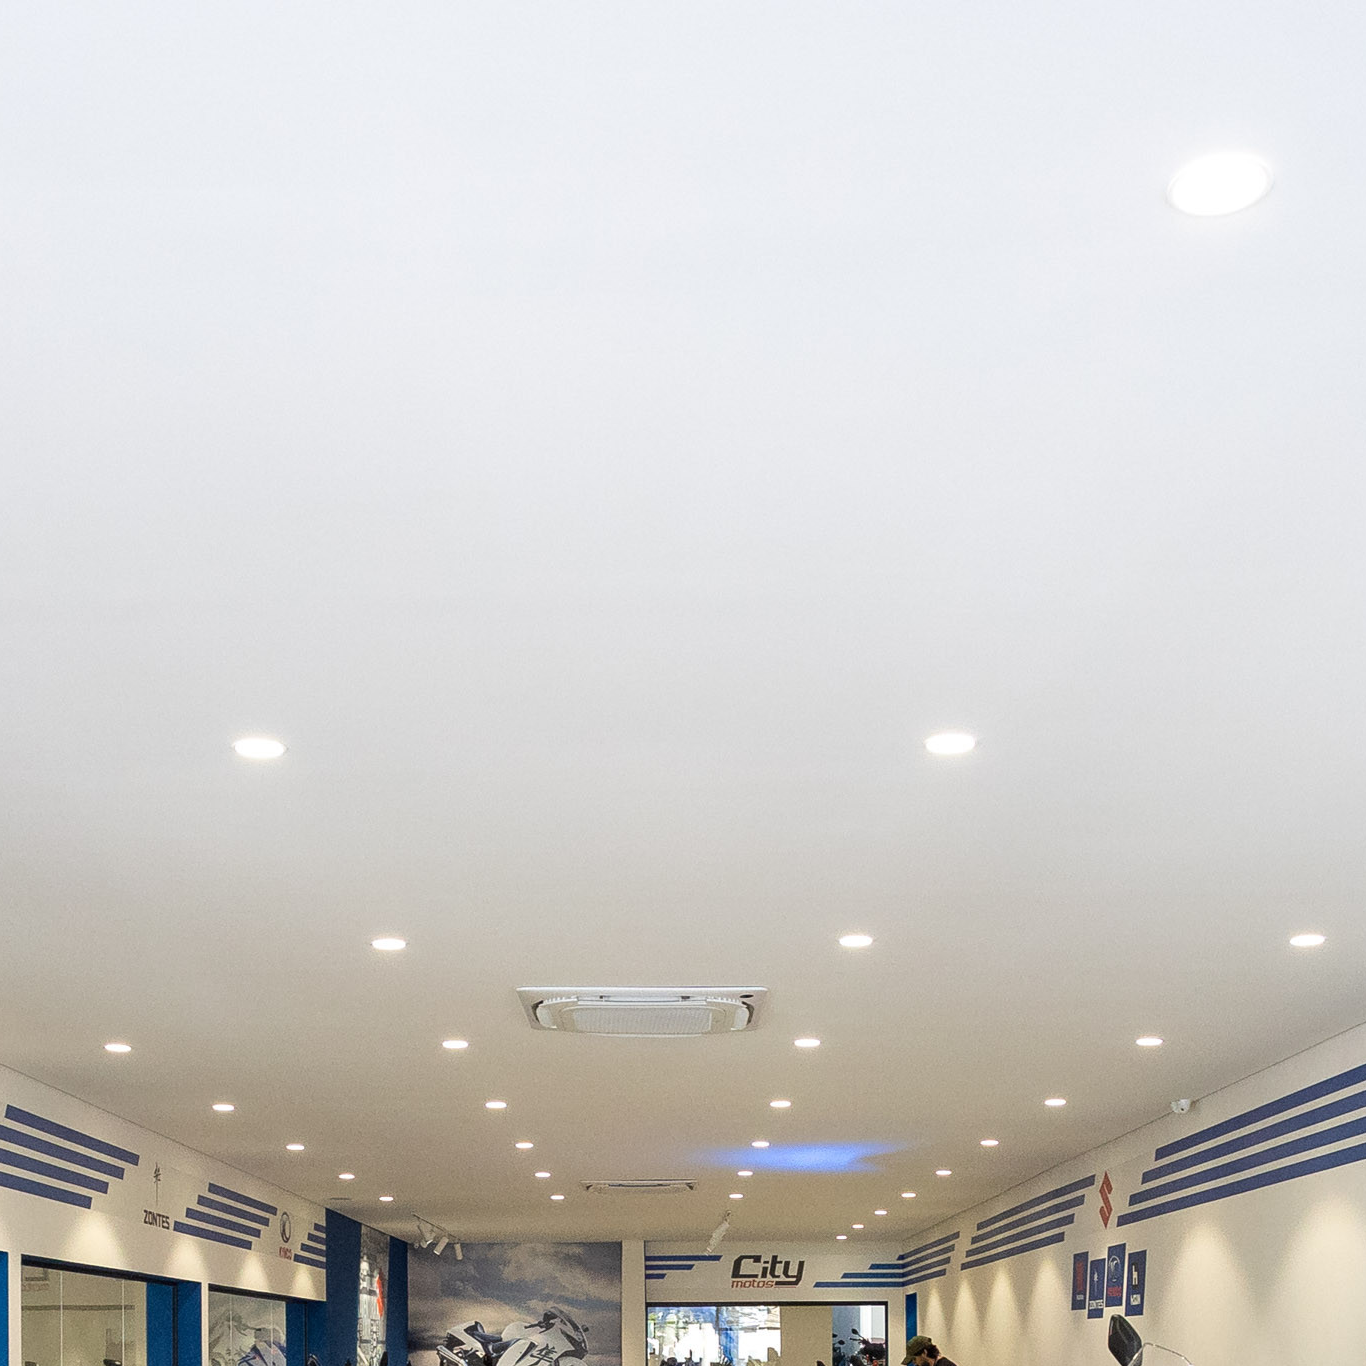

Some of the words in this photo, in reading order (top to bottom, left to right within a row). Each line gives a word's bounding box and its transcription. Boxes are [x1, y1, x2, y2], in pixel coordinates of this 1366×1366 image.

[143, 1209, 170, 1230] ZONTES
[731, 1255, 805, 1286] City
[731, 1279, 775, 1289] motos
